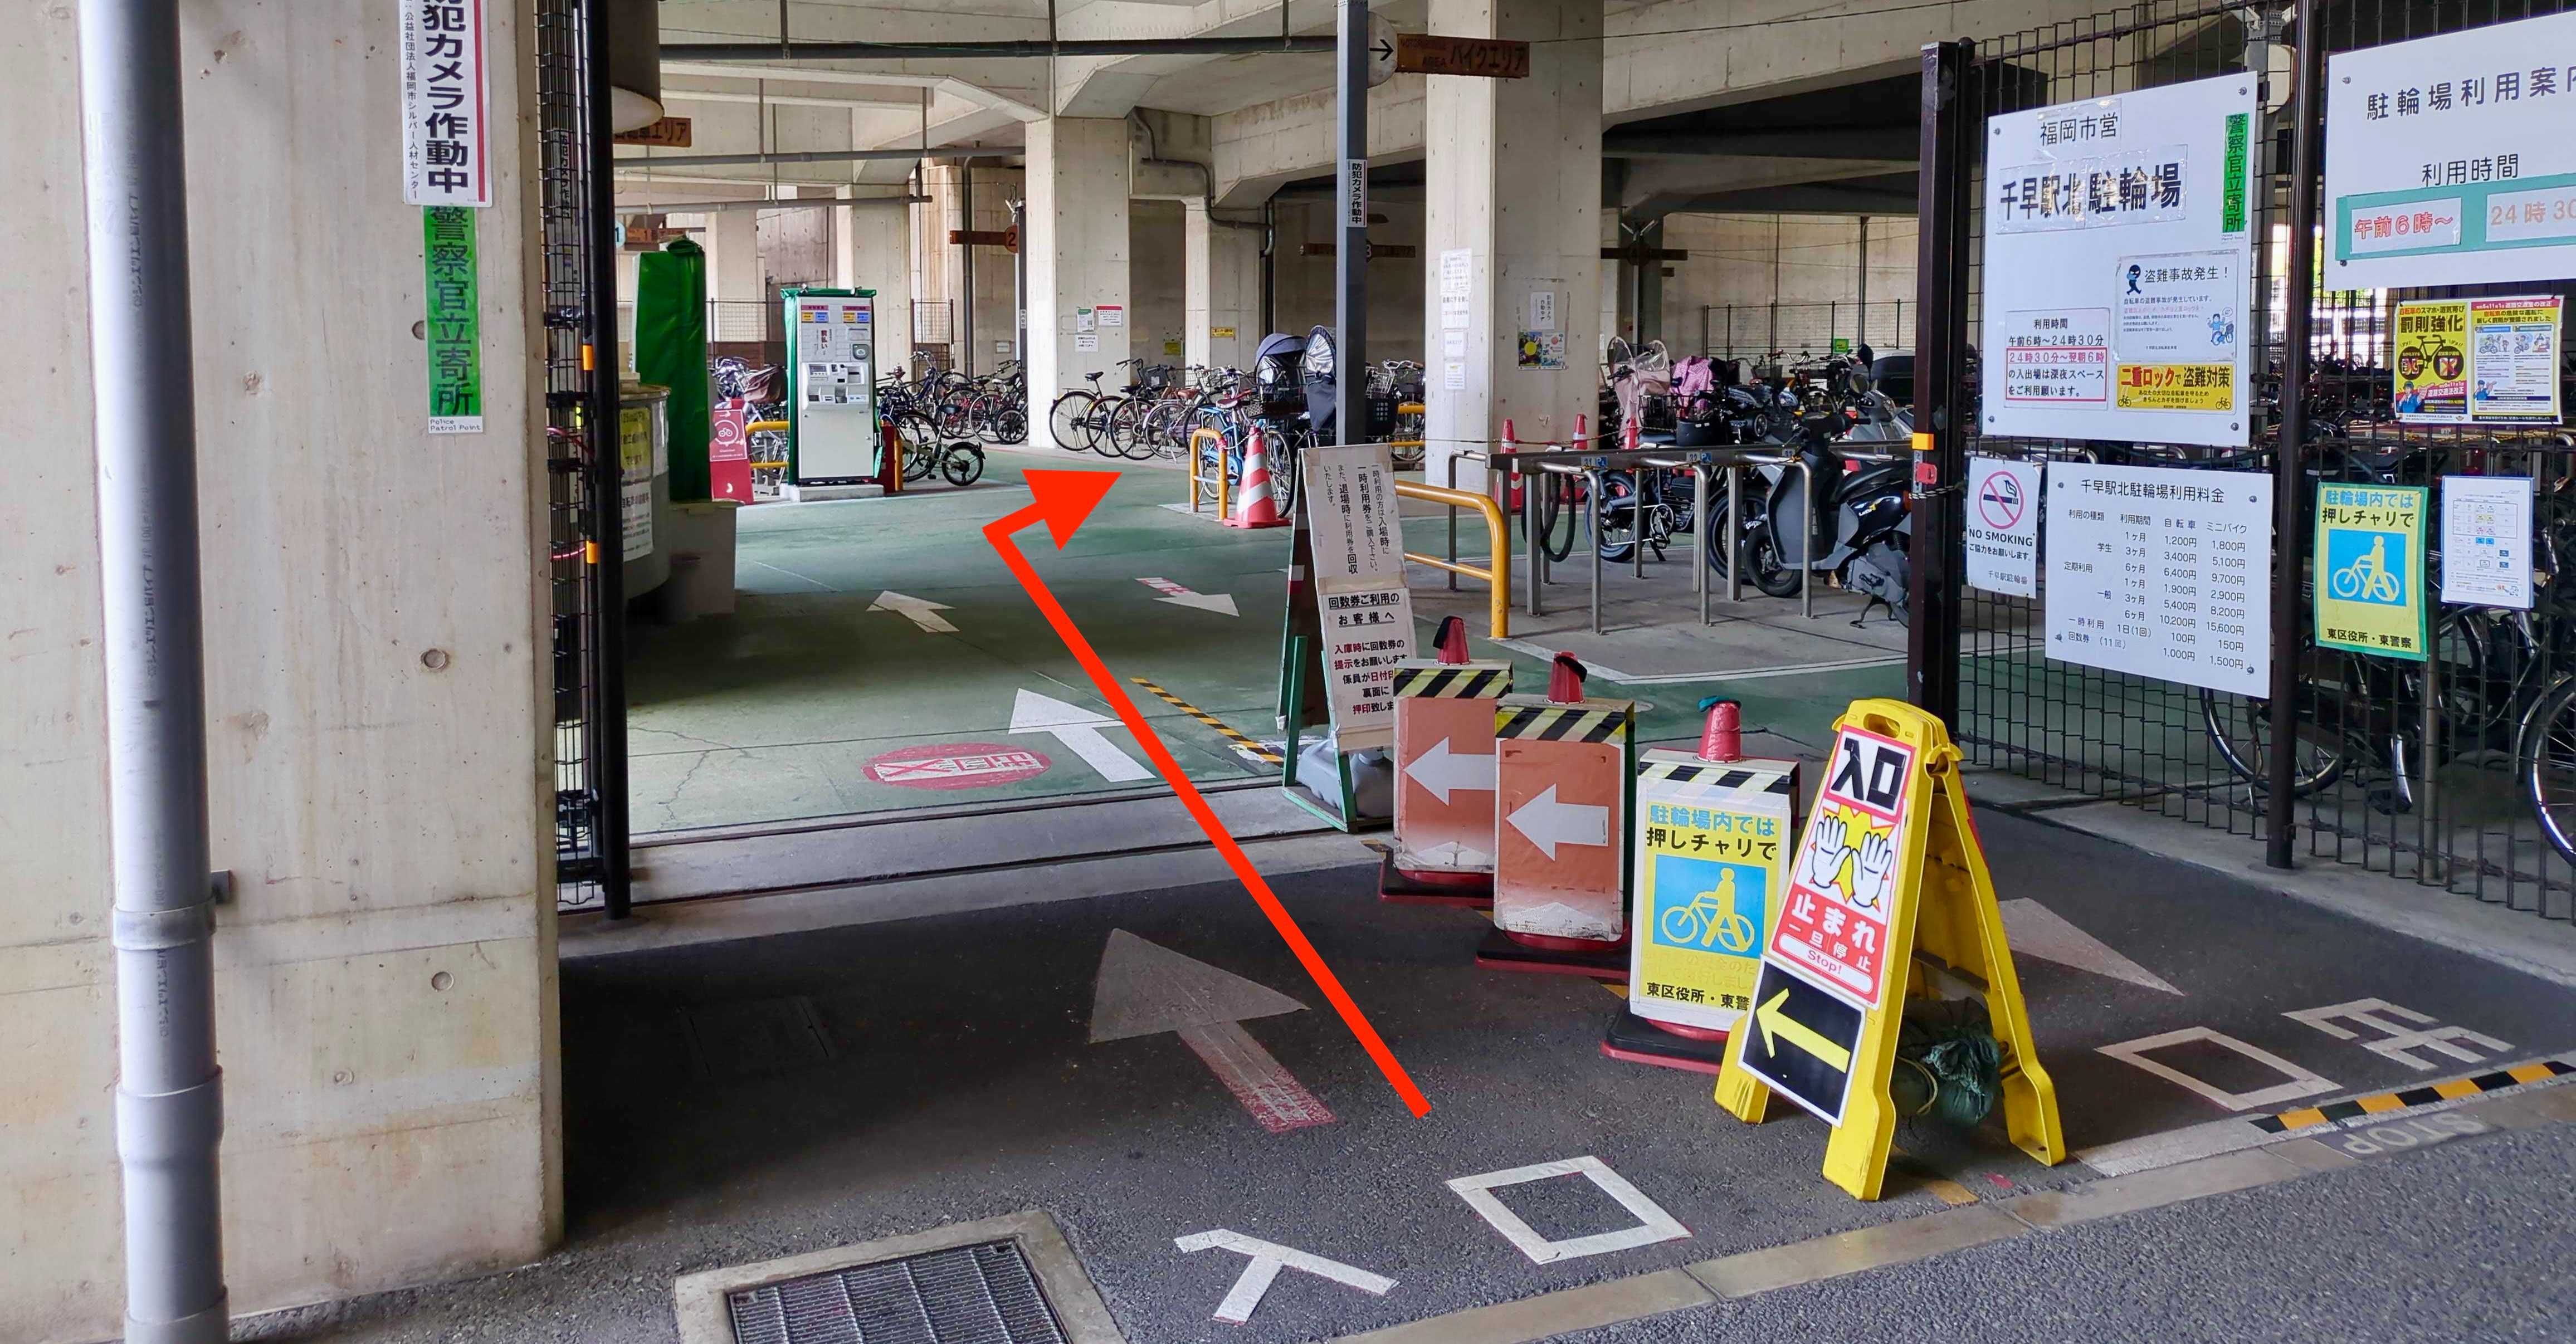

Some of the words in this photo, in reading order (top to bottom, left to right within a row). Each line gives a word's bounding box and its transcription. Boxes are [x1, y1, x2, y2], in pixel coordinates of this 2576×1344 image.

[422, 0, 468, 193] 犯カメラ作動中
[2040, 112, 2118, 146] 福岡市営
[2226, 114, 2245, 232] 警察官立寄所
[2422, 154, 2518, 187] 利用時間
[1352, 163, 1362, 223] 防犯カメラ作動中
[2001, 163, 2182, 221] 千早駅北駐輪場
[1008, 232, 1016, 246] 2
[431, 207, 472, 416] 警察官立寄所
[2034, 319, 2068, 330] 利用時間
[2401, 315, 2463, 333] 罰則強化
[2008, 369, 2104, 380] の入出場は深夜スペース
[2008, 385, 2080, 397] をご利用願います。
[2081, 479, 2224, 503] 千早駅北駐輪場利用料金
[2325, 490, 2414, 508] 駐輪場内では
[1372, 465, 1389, 555] 一時利用の方は入場時に
[2068, 509, 2104, 521] 利用の種類
[2322, 507, 2414, 527] 押しチャリで
[1338, 465, 1358, 575] また、退場時に利用券を回収
[2120, 514, 2150, 526] 利用期間
[2164, 518, 2196, 530] 自転車
[2207, 521, 2247, 534] ミニバイク
[1969, 529, 1982, 539] NO
[1985, 531, 2033, 546] SMOKING
[1969, 543, 2032, 561] ご協力をお願いします。
[2097, 543, 2112, 553] 学生
[2064, 561, 2093, 574] 定期利用
[1329, 593, 1400, 608] 回数券ご利用の
[2097, 590, 2112, 600] 一般
[1339, 612, 1394, 625] お客様へ
[2068, 617, 2104, 629] 一時利用
[2068, 631, 2090, 643] 回数券
[2171, 632, 2196, 645] 100円
[2218, 639, 2244, 652] 150円
[2327, 628, 2412, 648] 東区役所・東警察
[1334, 639, 1404, 654] 入庫時に回数券の
[1363, 686, 1389, 698] 裏面に
[1831, 737, 1907, 811] 入口
[1650, 805, 1774, 837] 駐輪場内では
[1647, 827, 1777, 861] 押しチャリで
[1791, 893, 1876, 953] 止まれ
[1788, 923, 1872, 973] 一旦停止
[1808, 950, 1842, 974] Stop!
[2343, 1113, 2486, 1154] STOP
